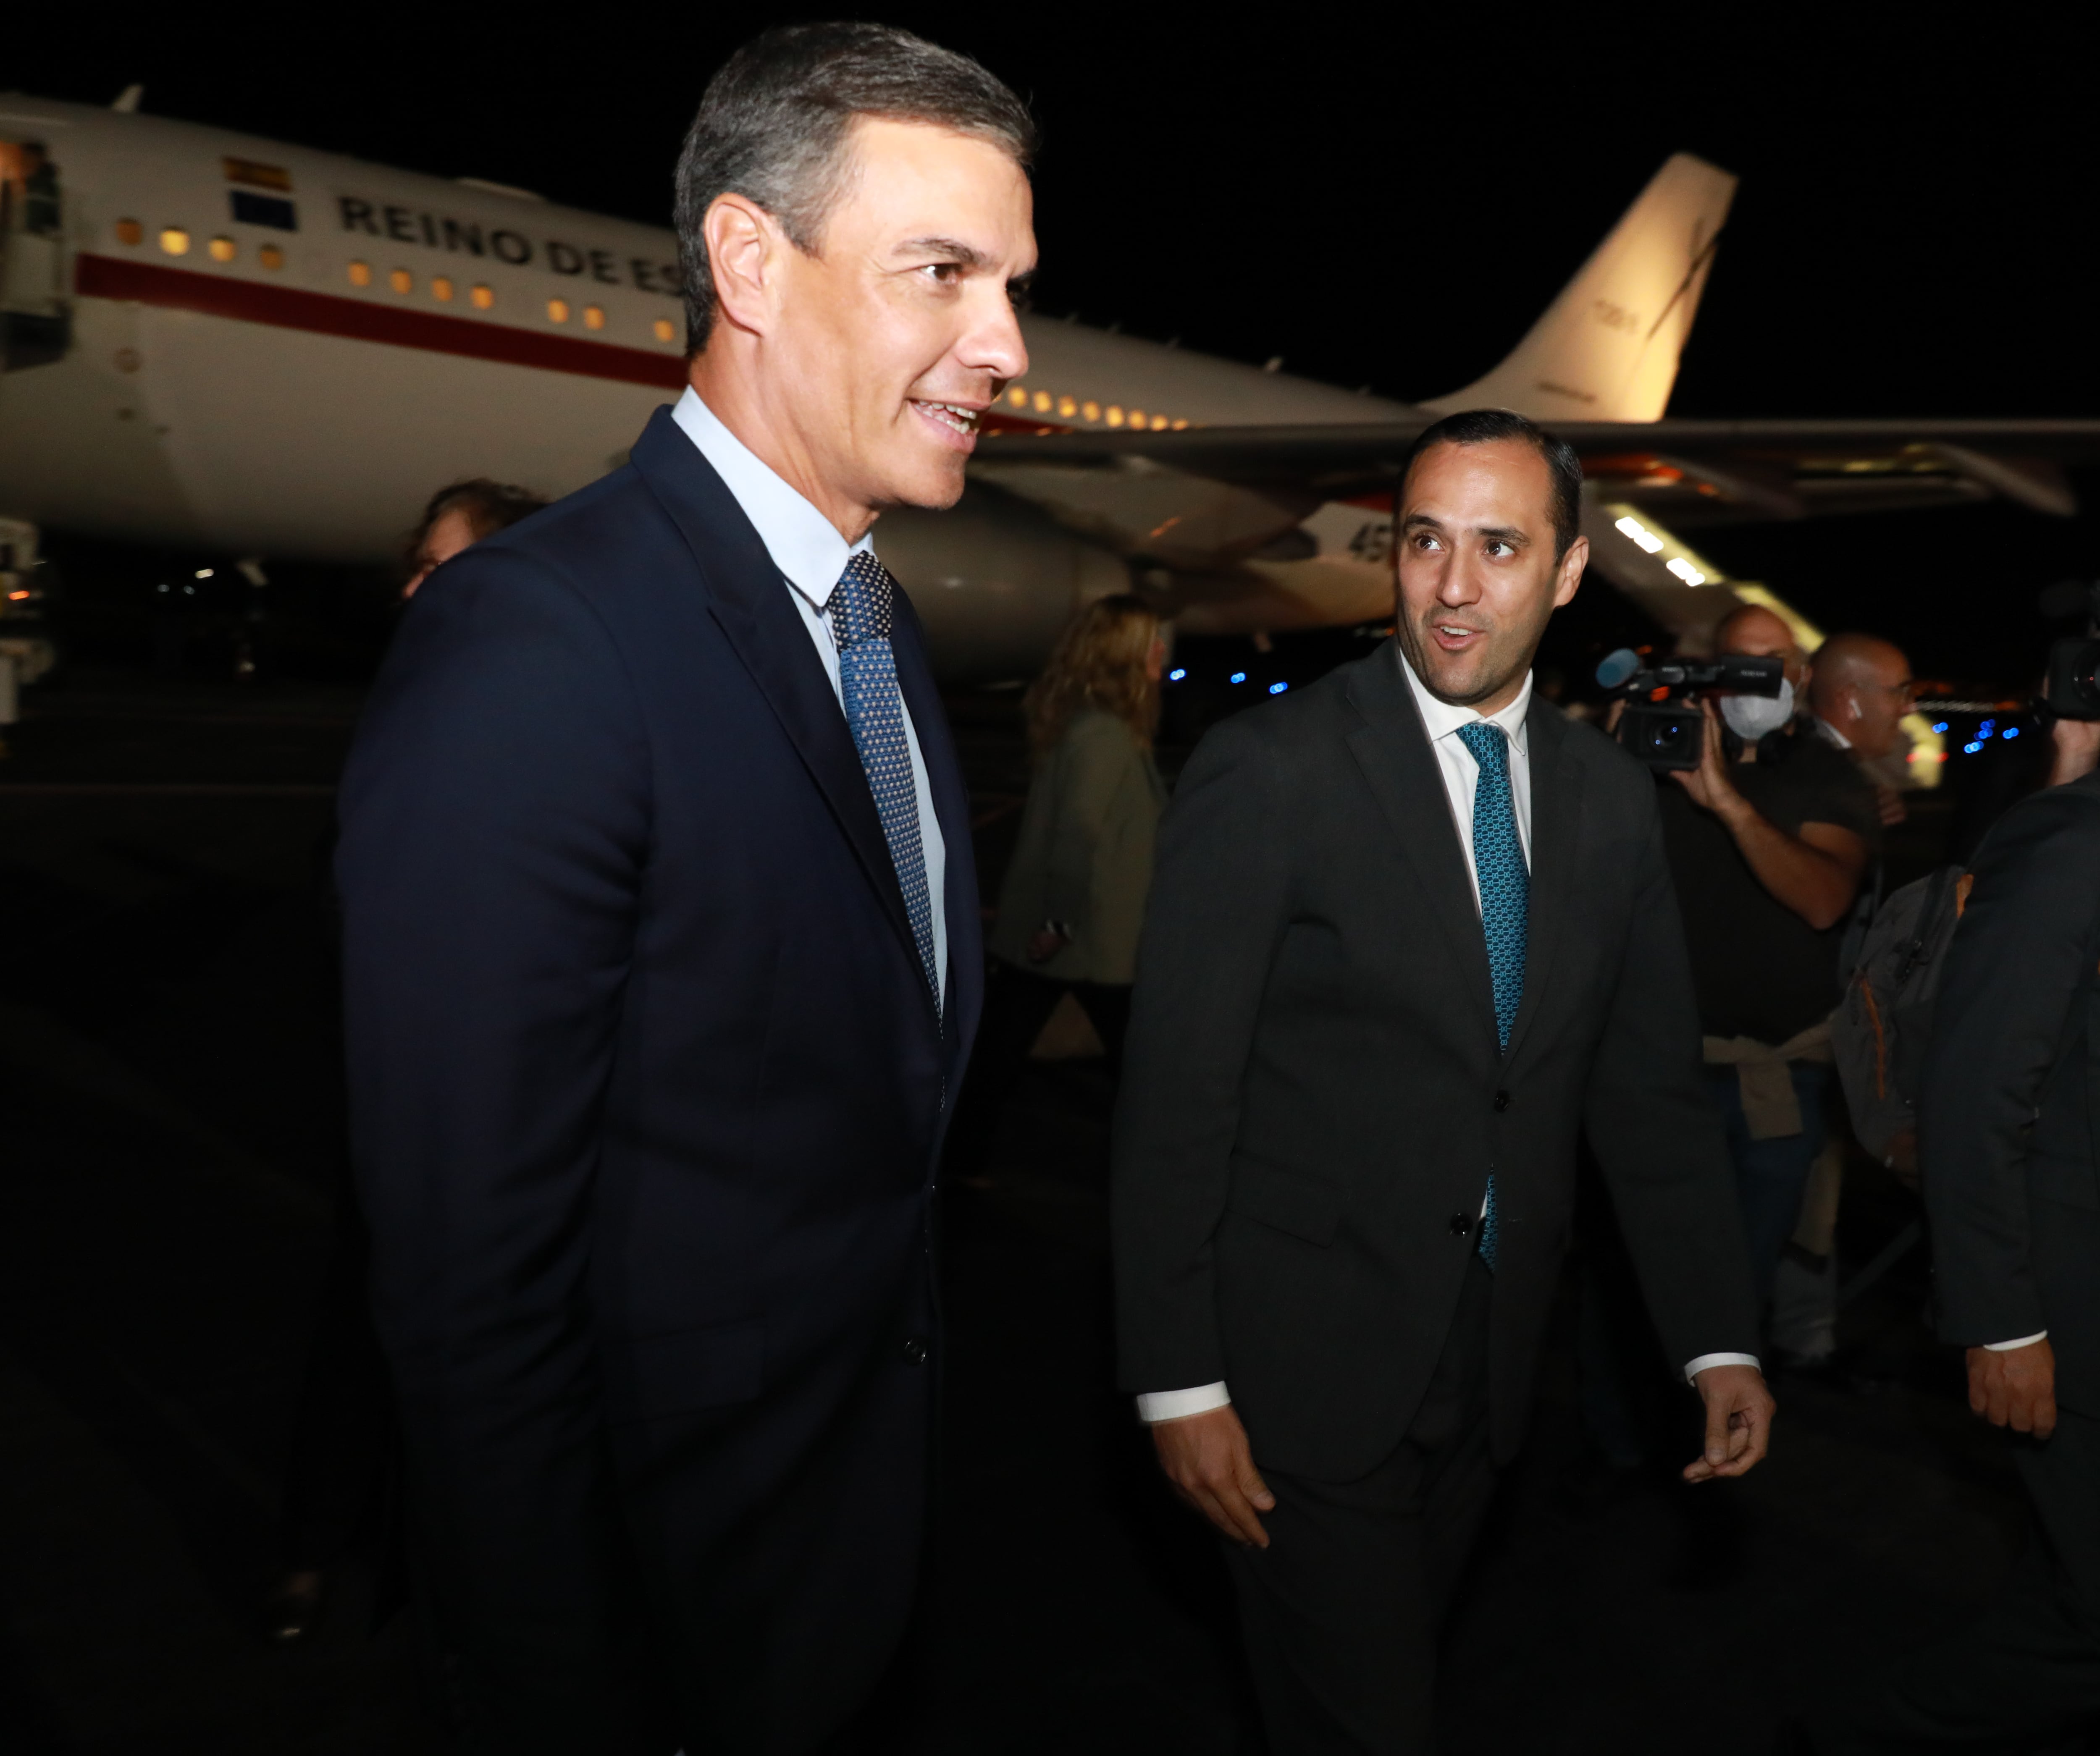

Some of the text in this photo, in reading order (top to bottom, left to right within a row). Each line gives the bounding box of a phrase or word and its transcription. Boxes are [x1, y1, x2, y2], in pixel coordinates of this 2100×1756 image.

[339, 196, 532, 265] REINO
[547, 241, 620, 285] DE
[1348, 522, 1392, 563] 45
